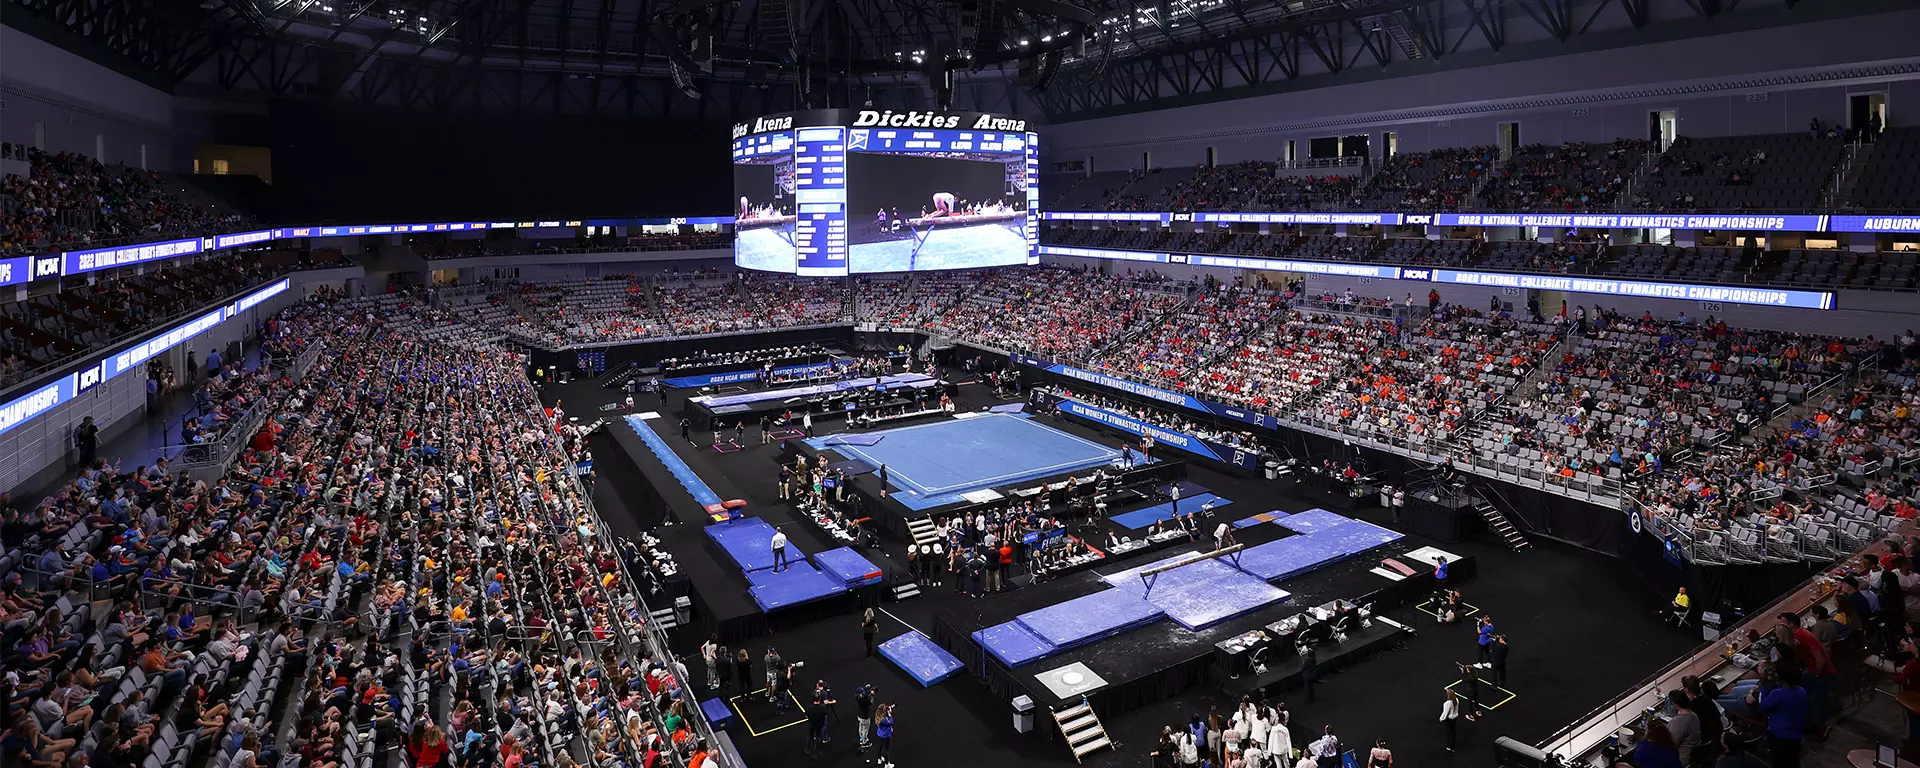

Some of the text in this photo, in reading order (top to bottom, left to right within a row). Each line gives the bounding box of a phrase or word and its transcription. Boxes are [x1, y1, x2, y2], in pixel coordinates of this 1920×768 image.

[1748, 93, 1766, 102] 226
[753, 116, 793, 134] Arena
[853, 110, 1026, 132] Dickies Arena
[1406, 215, 1431, 224] NCAA
[1458, 215, 1784, 229] 2022 NATIONAL COLLEGIATE WOMEN'S GYMNASTICS CHAMPIONSHIPS
[1864, 218, 1920, 230] AUBURN
[37, 257, 59, 277] NCAA
[79, 253, 94, 270] 2022
[1404, 269, 1430, 280] NCAA
[1481, 275, 1519, 286] NATIONAL
[1521, 277, 1571, 289] COLLEGIATE
[1573, 280, 1617, 293] WOMEN'S
[1620, 283, 1686, 297] GYMNASTICS
[1689, 287, 1787, 304] CHAMPIONSHIPS
[1504, 288, 1518, 296] 125
[1702, 302, 1720, 312] 126
[81, 365, 100, 390] NCAA
[1063, 367, 1186, 406] NCAA WOMEN'S GYMNASTICS CHAMPIONSHIPS
[0, 385, 58, 430] CHAMPIONSHIPS
[1072, 404, 1188, 447] NCAA WOMEN'S GYMNASTICS CHAMPIONSHIPS
